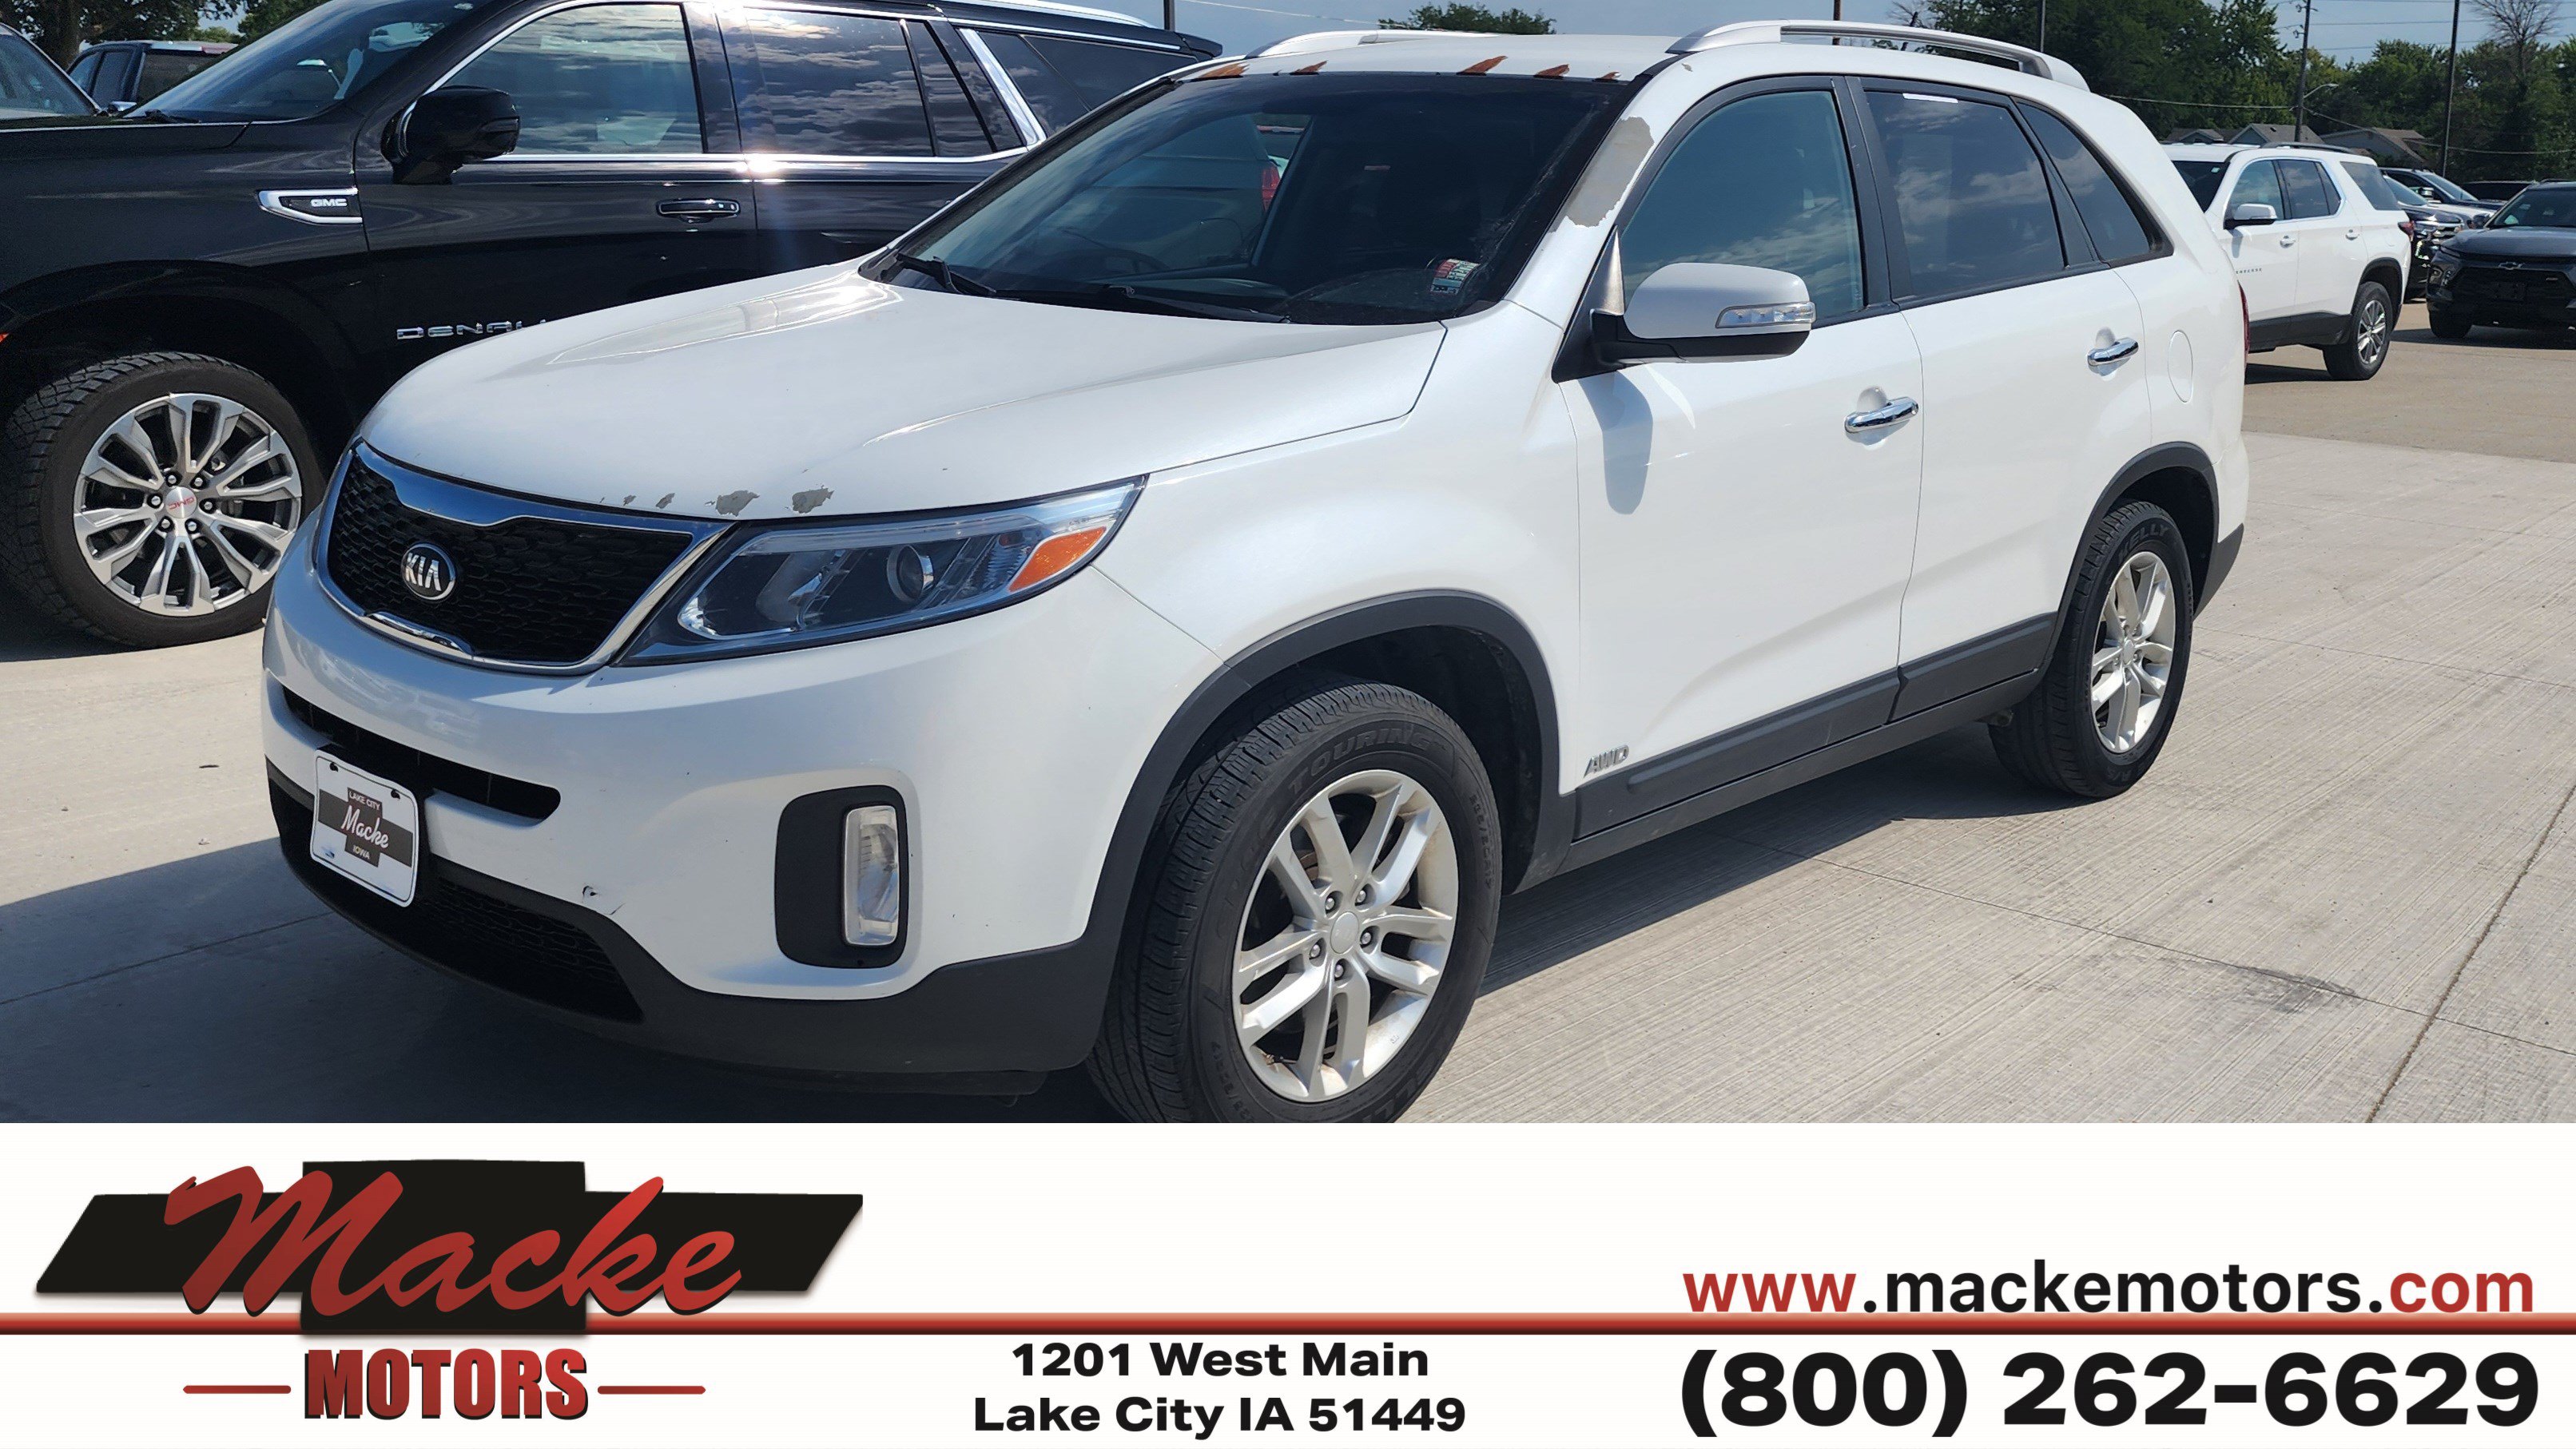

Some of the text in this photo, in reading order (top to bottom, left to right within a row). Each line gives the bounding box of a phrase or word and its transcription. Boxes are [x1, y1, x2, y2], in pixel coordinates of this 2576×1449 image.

[310, 198, 348, 207] GMC
[396, 319, 547, 339] DENA
[168, 496, 194, 510] GMC
[405, 552, 442, 591] KIA
[1288, 728, 1435, 795] TOURING
[1583, 744, 1630, 779] AWD
[348, 791, 381, 811] LAKE CITY
[340, 804, 389, 849] Macke
[352, 844, 371, 860] IOWA
